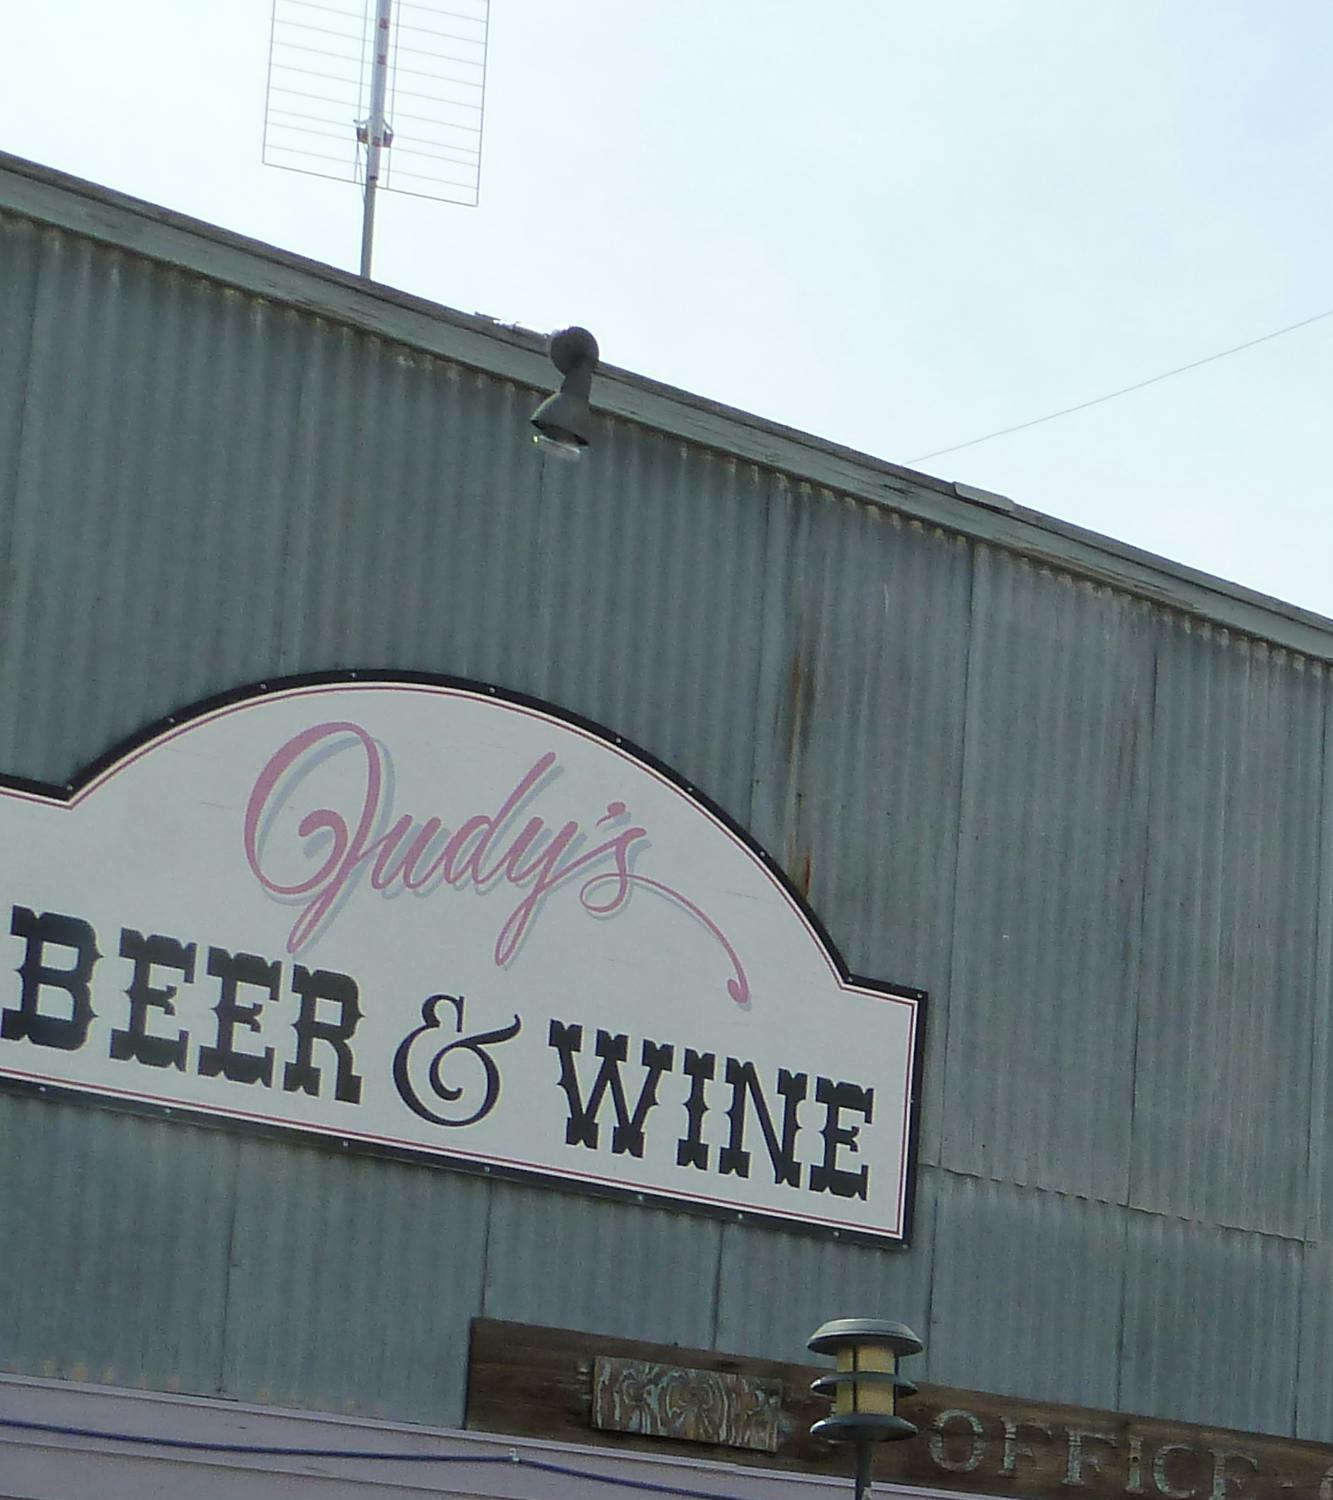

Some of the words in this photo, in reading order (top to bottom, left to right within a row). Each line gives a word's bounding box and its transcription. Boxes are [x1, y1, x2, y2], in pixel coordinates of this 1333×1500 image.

[245, 719, 660, 968] Judy's
[0, 905, 366, 1105] BEER
[393, 994, 521, 1128] &
[548, 1019, 876, 1201] WINE
